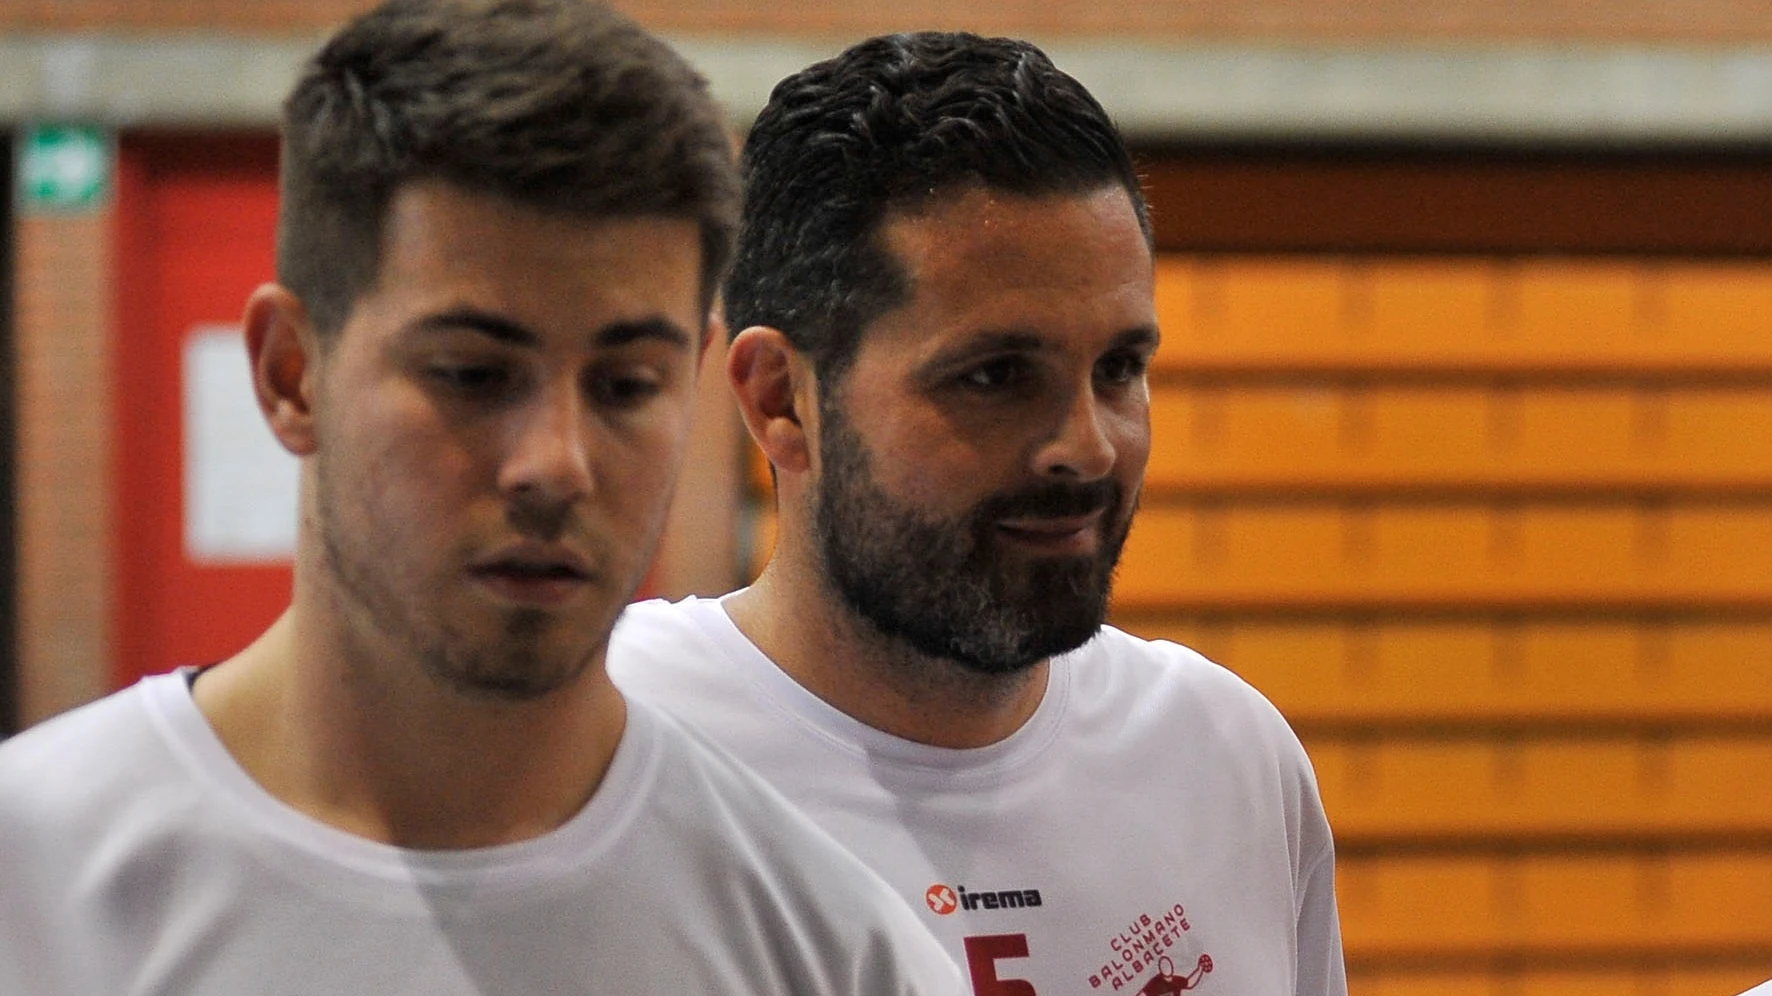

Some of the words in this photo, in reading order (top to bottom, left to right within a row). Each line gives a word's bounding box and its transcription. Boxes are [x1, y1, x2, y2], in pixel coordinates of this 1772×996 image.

[958, 884, 1042, 910] irema
[1088, 903, 1185, 989] BALONMANO
[1110, 913, 1152, 952] CLUB
[1111, 917, 1191, 992] ALBACETE
